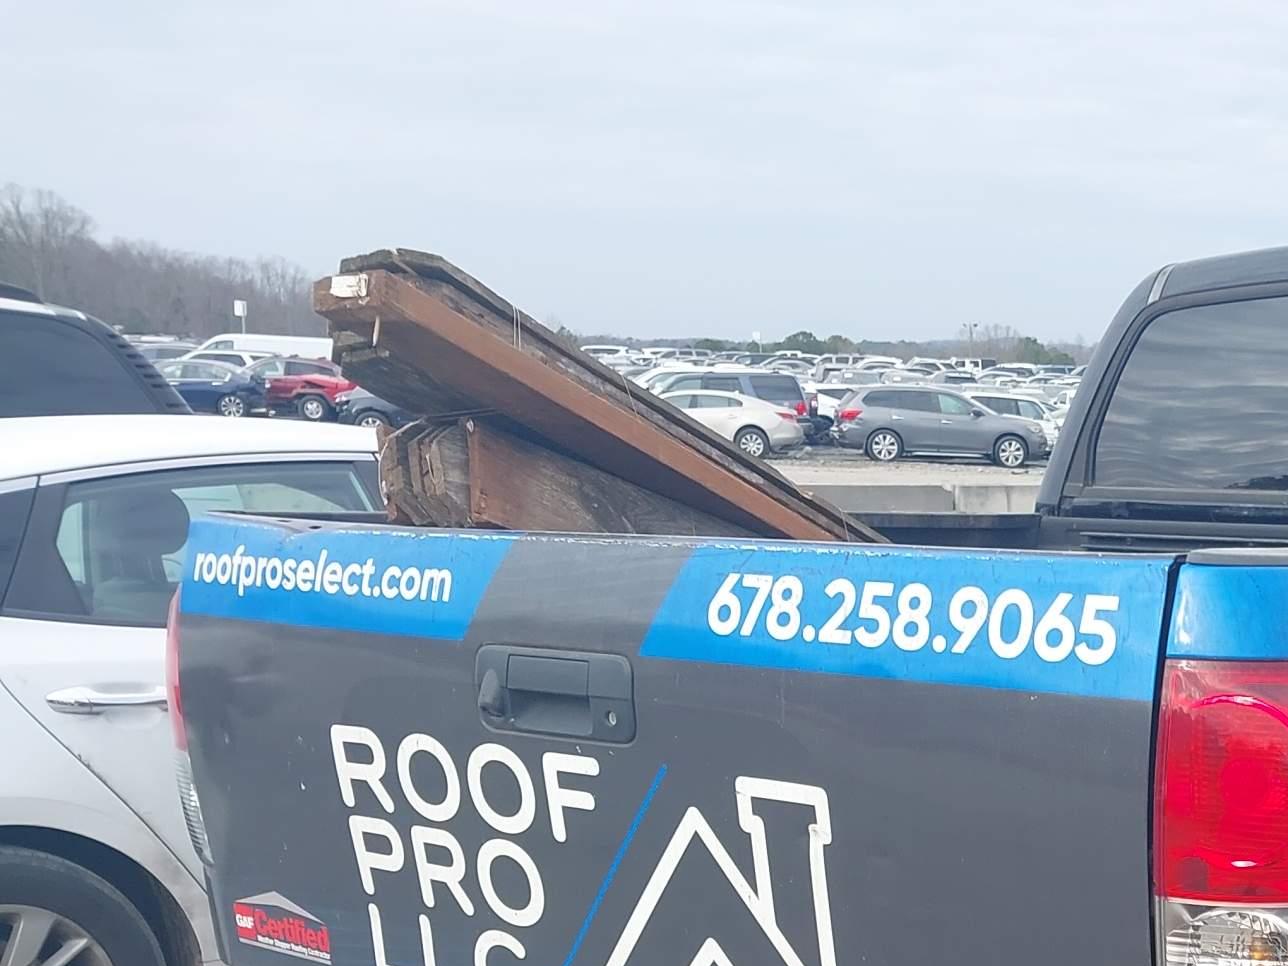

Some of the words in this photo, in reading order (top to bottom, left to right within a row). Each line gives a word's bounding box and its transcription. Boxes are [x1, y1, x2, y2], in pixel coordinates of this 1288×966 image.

[193, 545, 452, 602] roofproselect.com
[707, 573, 1120, 666] 678.258.9065
[330, 724, 600, 843] ROOF
[348, 814, 546, 927] PRO
[235, 912, 254, 930] GAF
[255, 909, 330, 952] Certified
